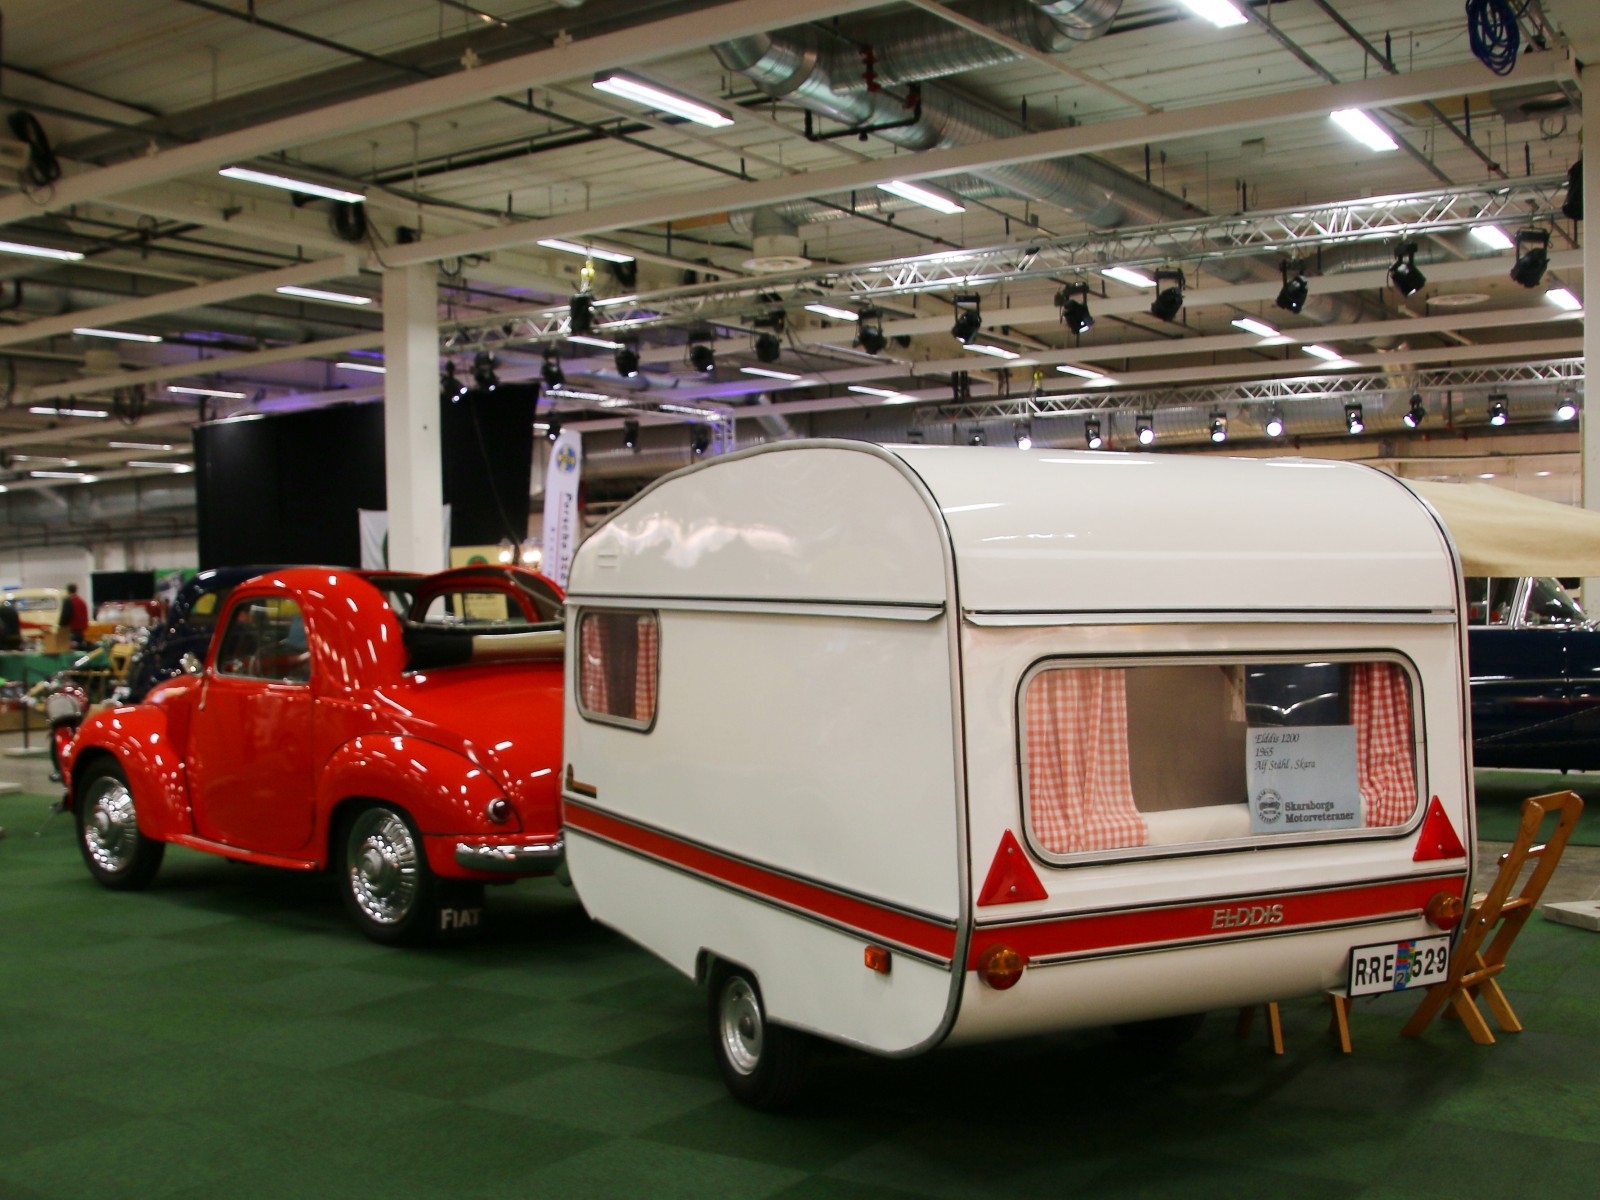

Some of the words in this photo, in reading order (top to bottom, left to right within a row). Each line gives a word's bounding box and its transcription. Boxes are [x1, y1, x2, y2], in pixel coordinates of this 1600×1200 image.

[1281, 733, 1300, 743] 1200
[1254, 759, 1269, 774] Alf
[1285, 801, 1335, 812] Skaraborgs
[1285, 812, 1355, 823] Motorveteraner
[441, 908, 482, 929] FIAT
[1211, 904, 1284, 929] ELDDIS
[1355, 954, 1394, 986] RRE
[1412, 946, 1447, 977] 529
